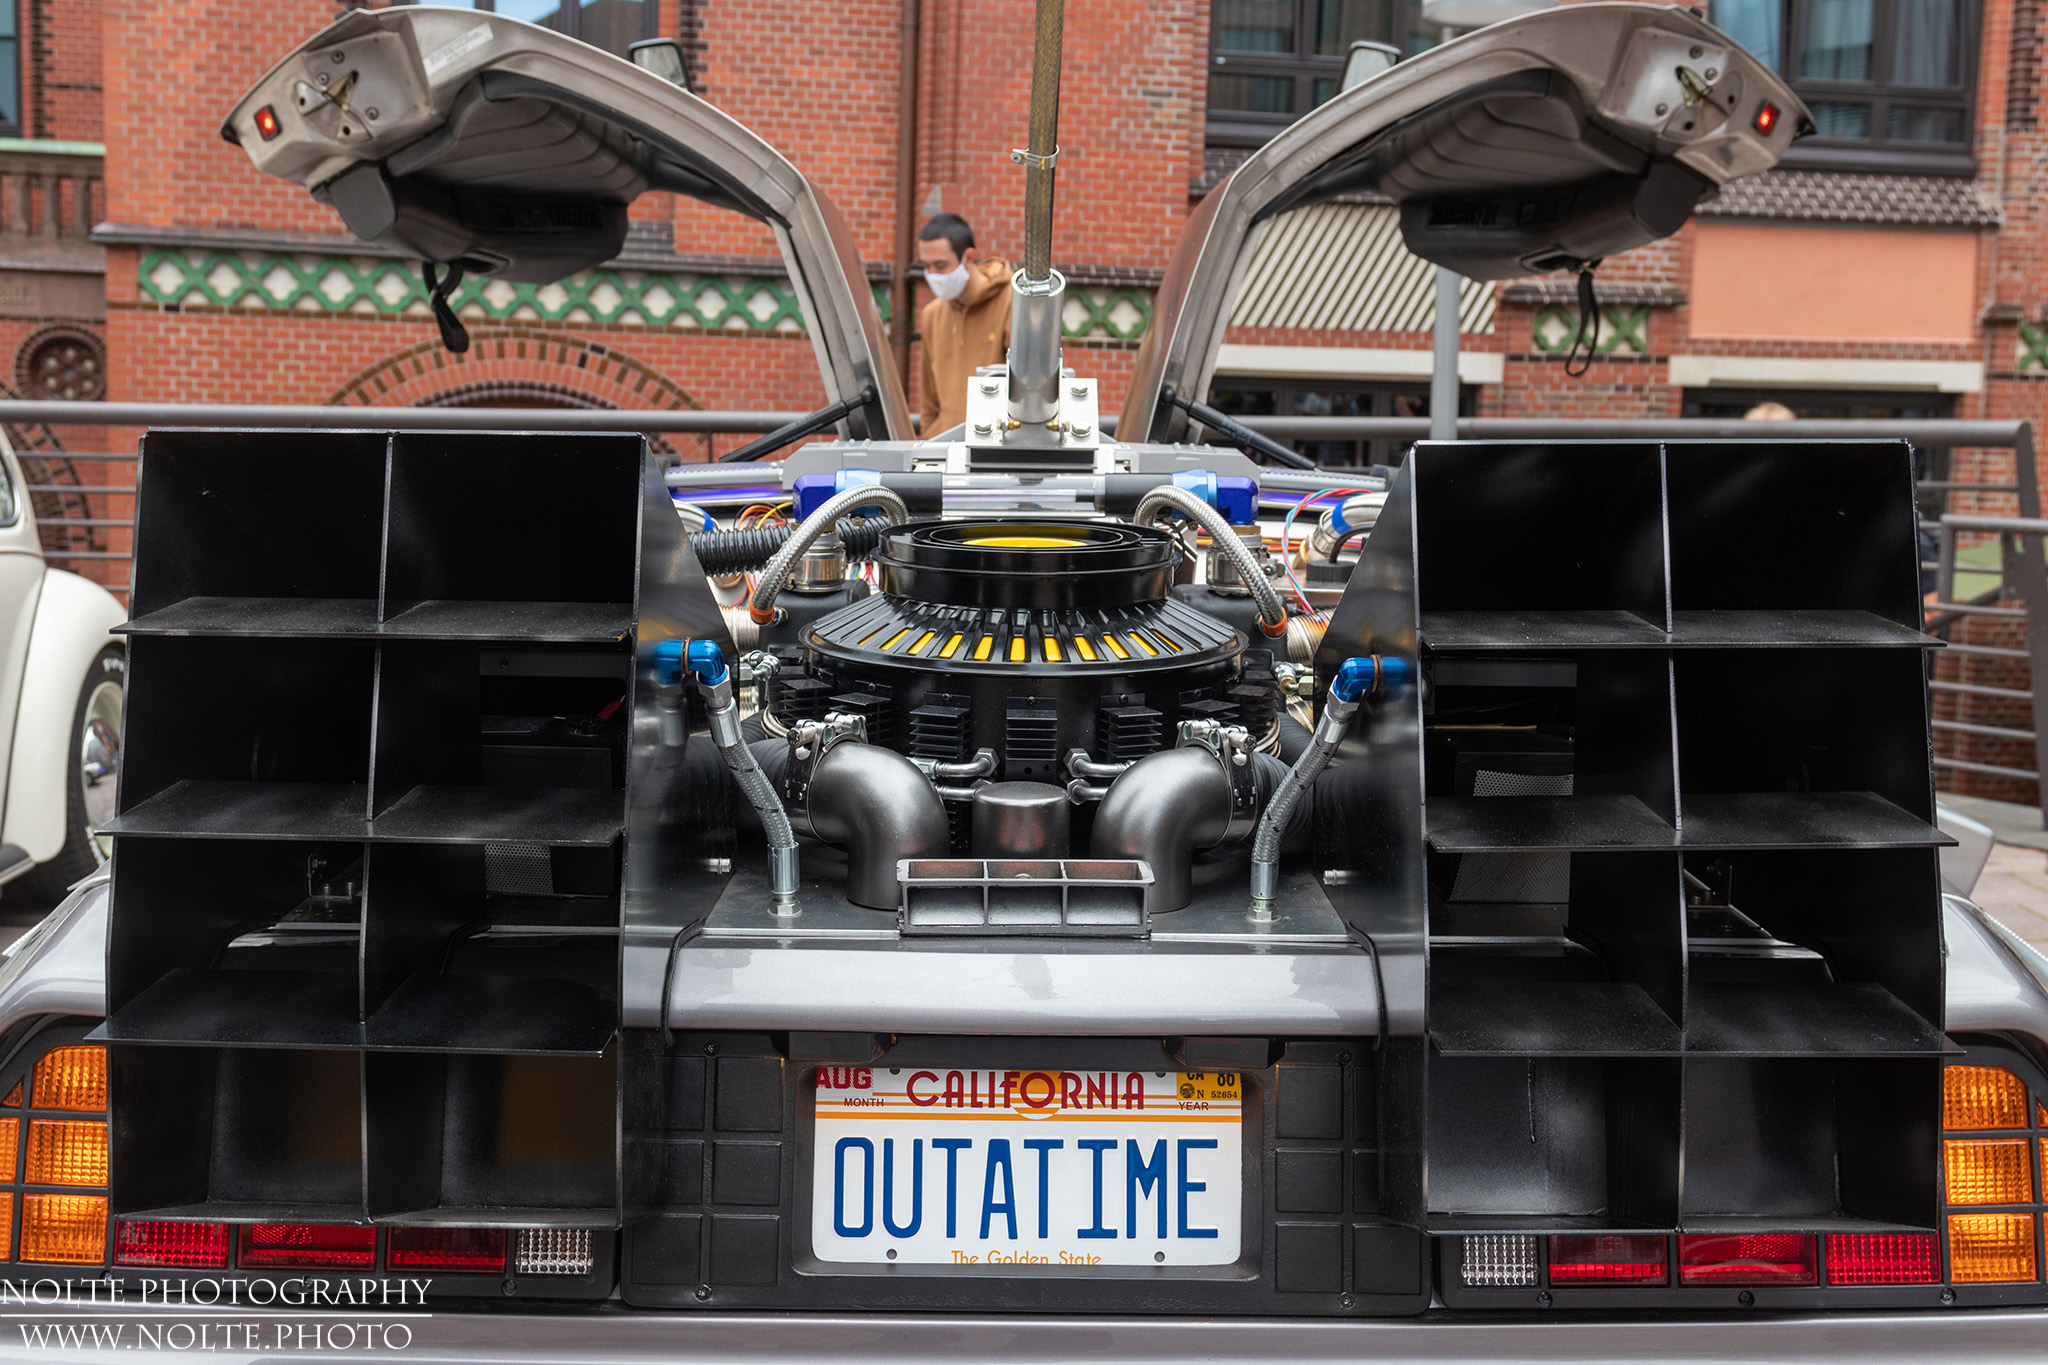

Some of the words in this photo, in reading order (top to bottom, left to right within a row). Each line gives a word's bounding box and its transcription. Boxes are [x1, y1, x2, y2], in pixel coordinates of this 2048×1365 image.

[816, 1067, 872, 1089] AUG
[906, 1070, 1144, 1110] CALIFORNIA
[1197, 1090, 1204, 1098] N
[1211, 1091, 1237, 1099] 52654
[843, 1098, 884, 1107] MONTH
[1178, 1102, 1209, 1110] YEAR
[834, 1137, 1218, 1239] OUTATIME
[951, 1250, 979, 1264] The
[987, 1250, 1049, 1264] Golden
[1059, 1250, 1102, 1265] State
